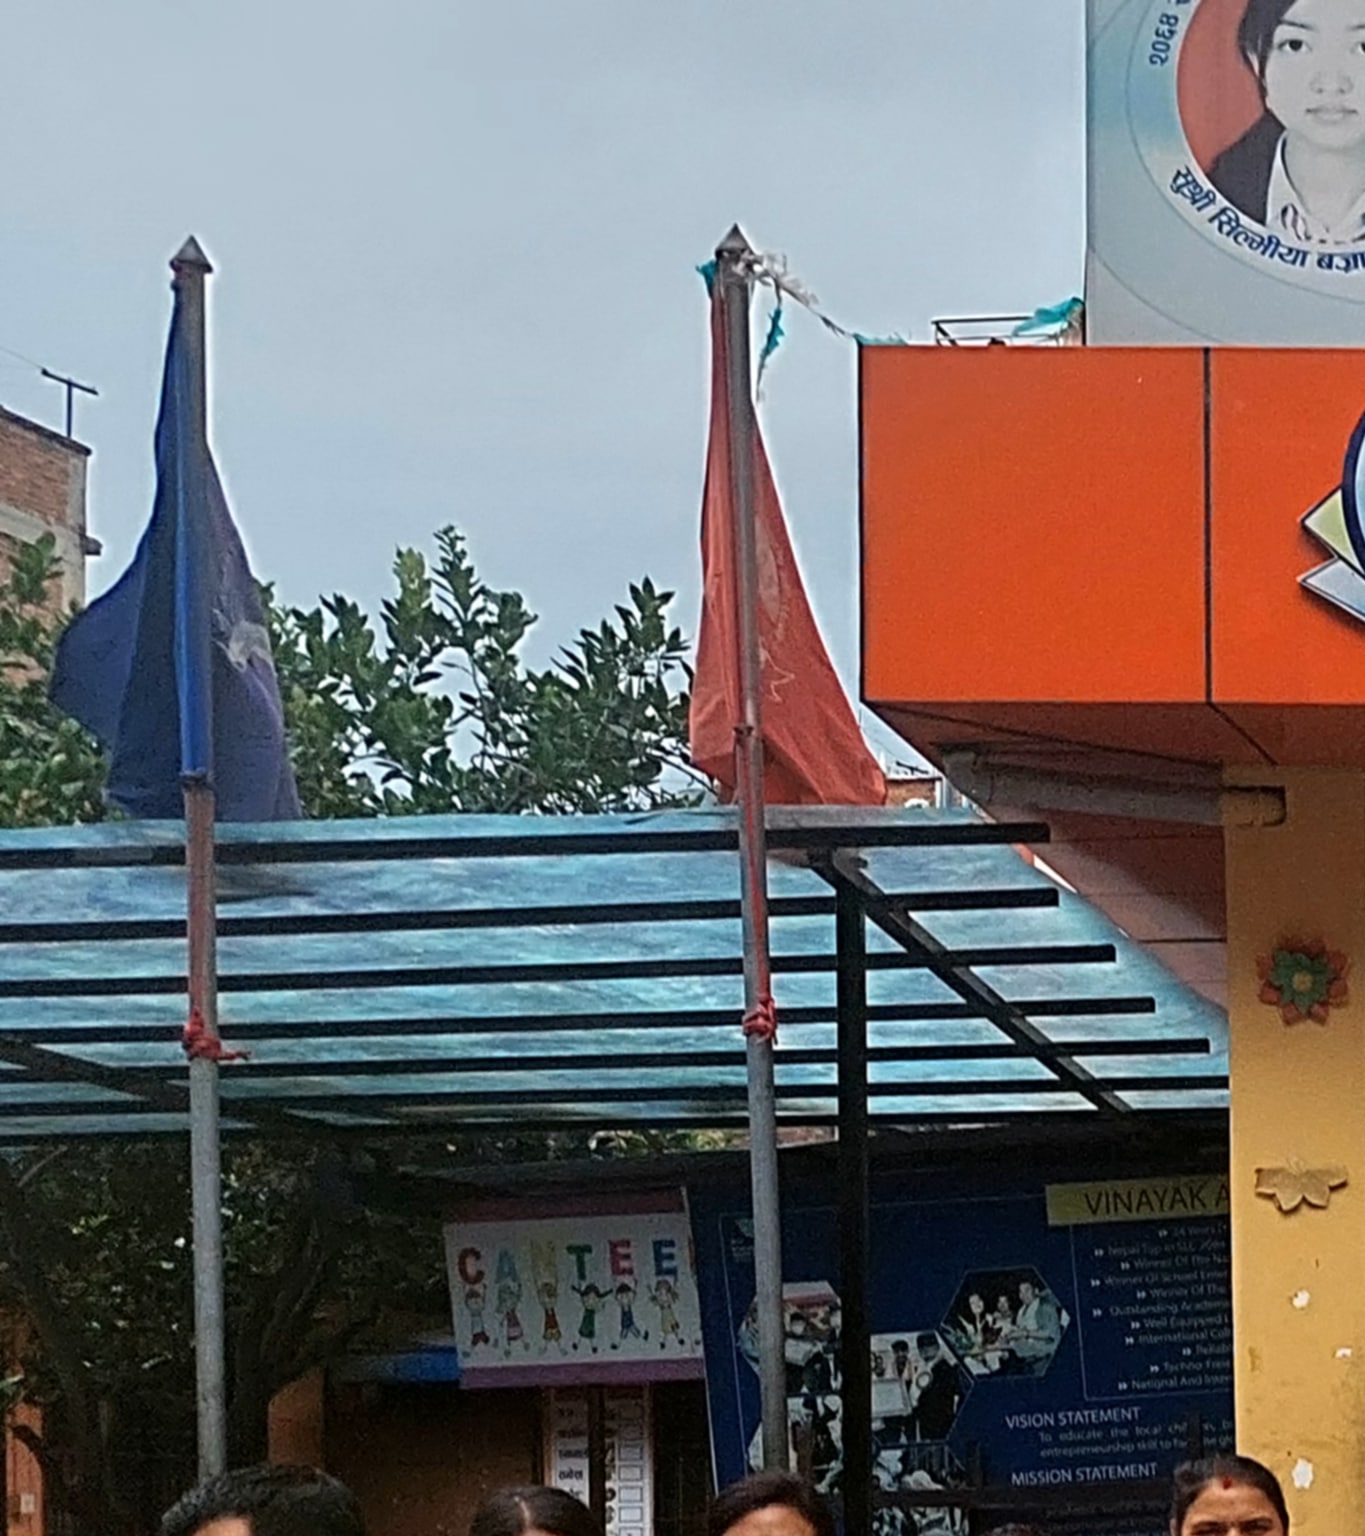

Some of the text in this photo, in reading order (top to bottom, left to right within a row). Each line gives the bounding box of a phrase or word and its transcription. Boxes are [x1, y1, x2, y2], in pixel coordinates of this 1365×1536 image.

[1085, 1185, 1208, 1216] VINAYAK
[1005, 1406, 1142, 1430] VISION STATEMENT
[1011, 1462, 1158, 1487] MISSION STATEMENT
